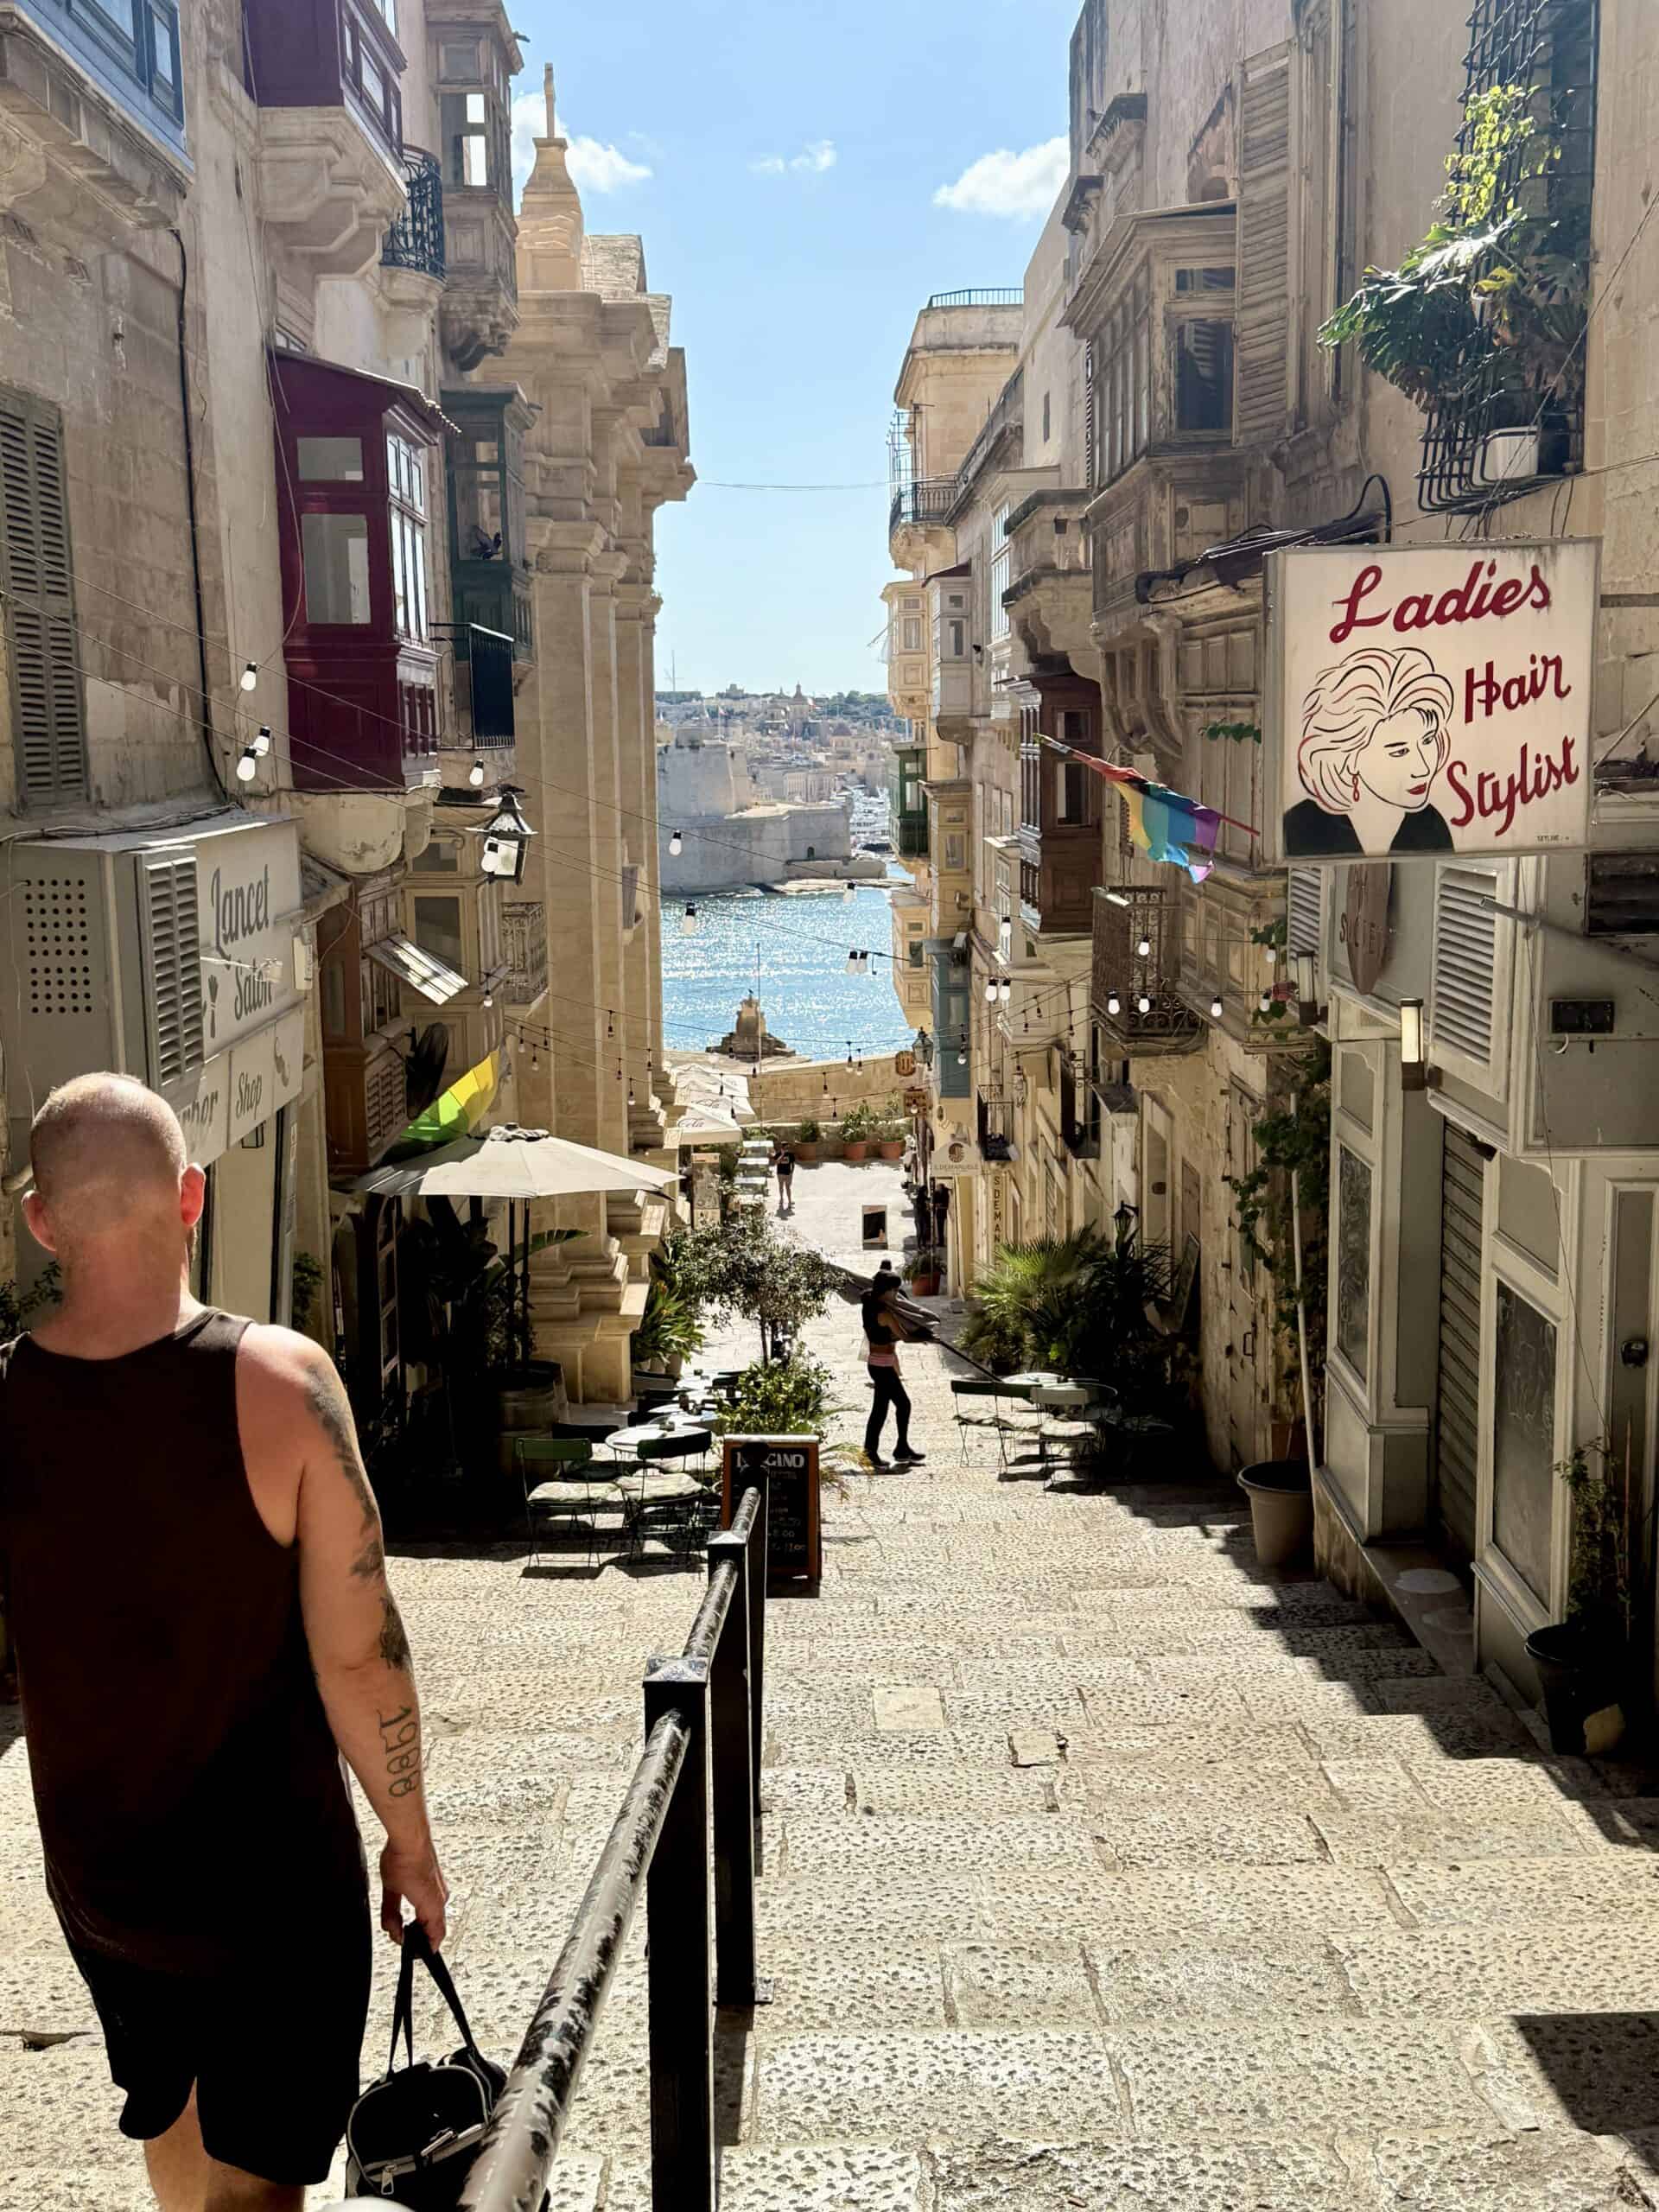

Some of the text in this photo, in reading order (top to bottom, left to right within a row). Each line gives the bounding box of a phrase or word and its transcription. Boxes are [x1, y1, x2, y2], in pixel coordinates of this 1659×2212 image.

[1329, 559, 1551, 643] Ladies
[1465, 653, 1572, 724] Hair
[1446, 735, 1580, 836] Stylist
[211, 864, 270, 969] Lancet
[234, 958, 272, 1020] Salon
[177, 1071, 263, 1126] rner Shop
[376, 1706, 421, 1797] 1988
